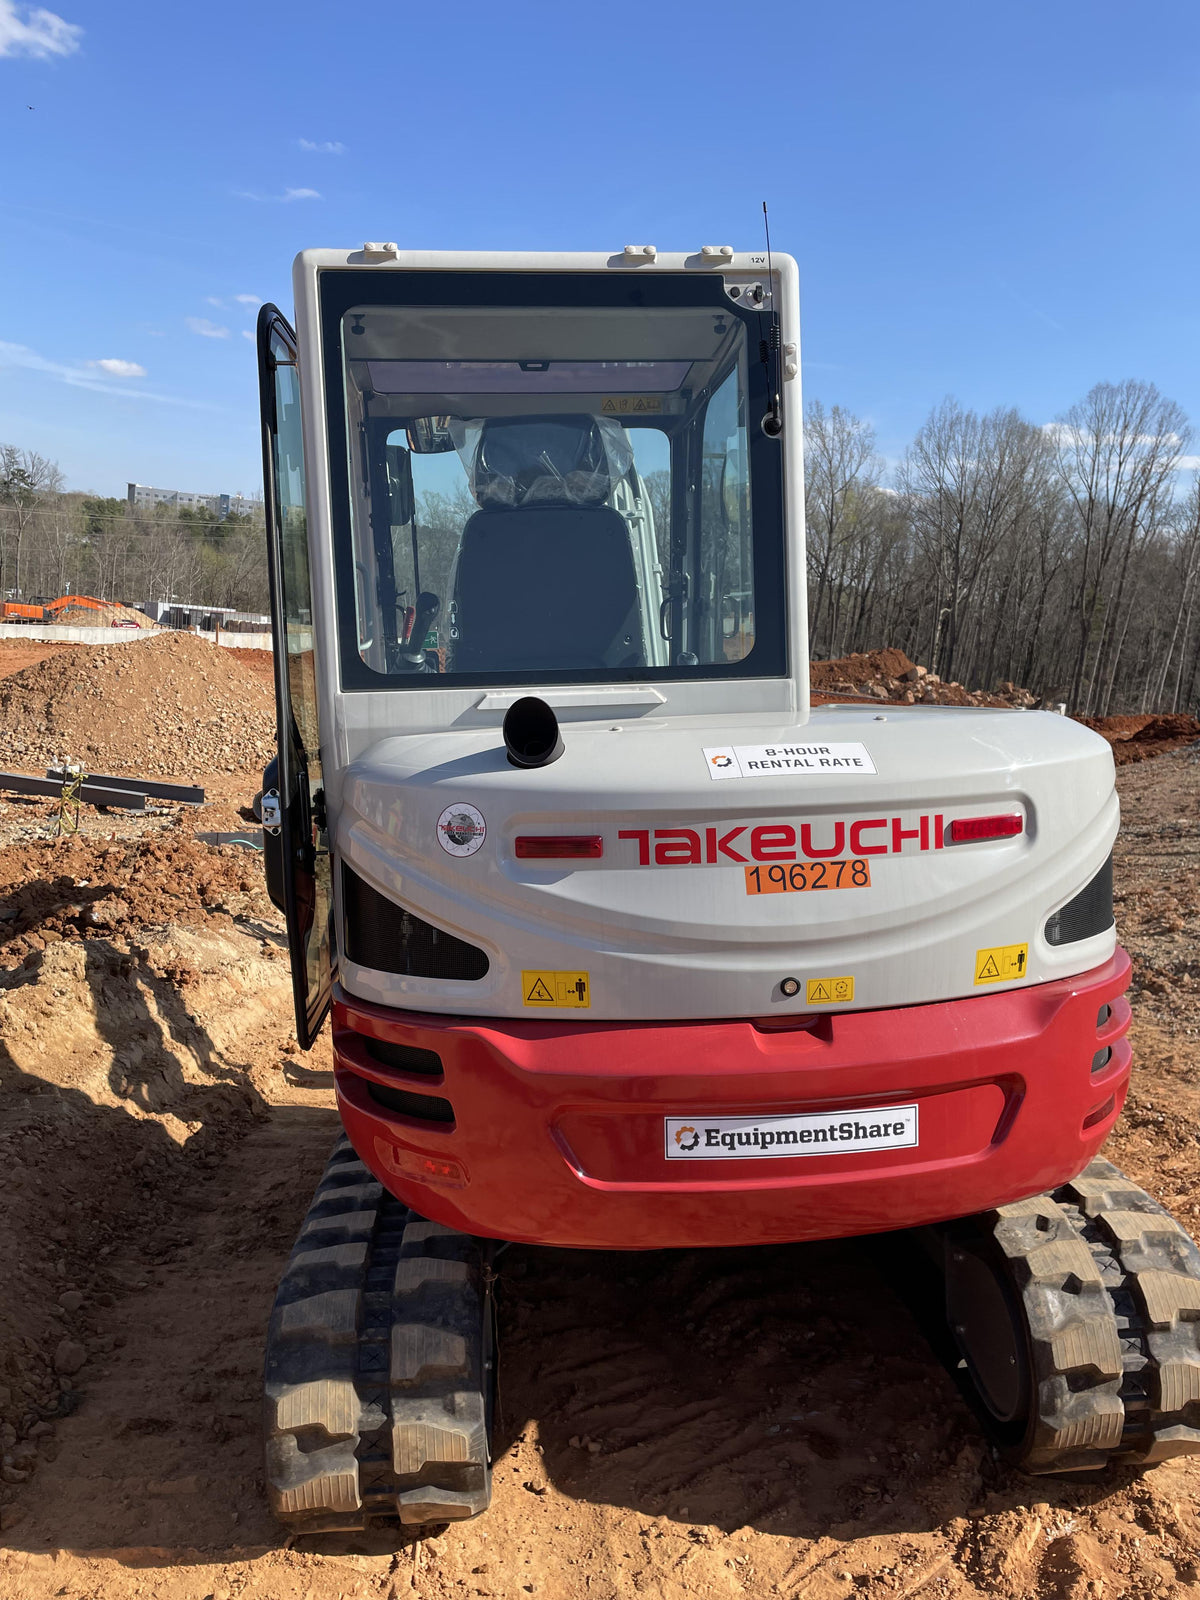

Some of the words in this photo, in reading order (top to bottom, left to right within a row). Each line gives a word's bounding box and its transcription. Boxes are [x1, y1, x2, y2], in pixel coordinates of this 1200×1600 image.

[765, 747, 831, 757] 8-HOUR
[747, 759, 815, 770] RENTAL
[818, 758, 864, 767] RATE
[749, 859, 869, 894] 196278
[704, 1121, 906, 1151] EquipmentShare
